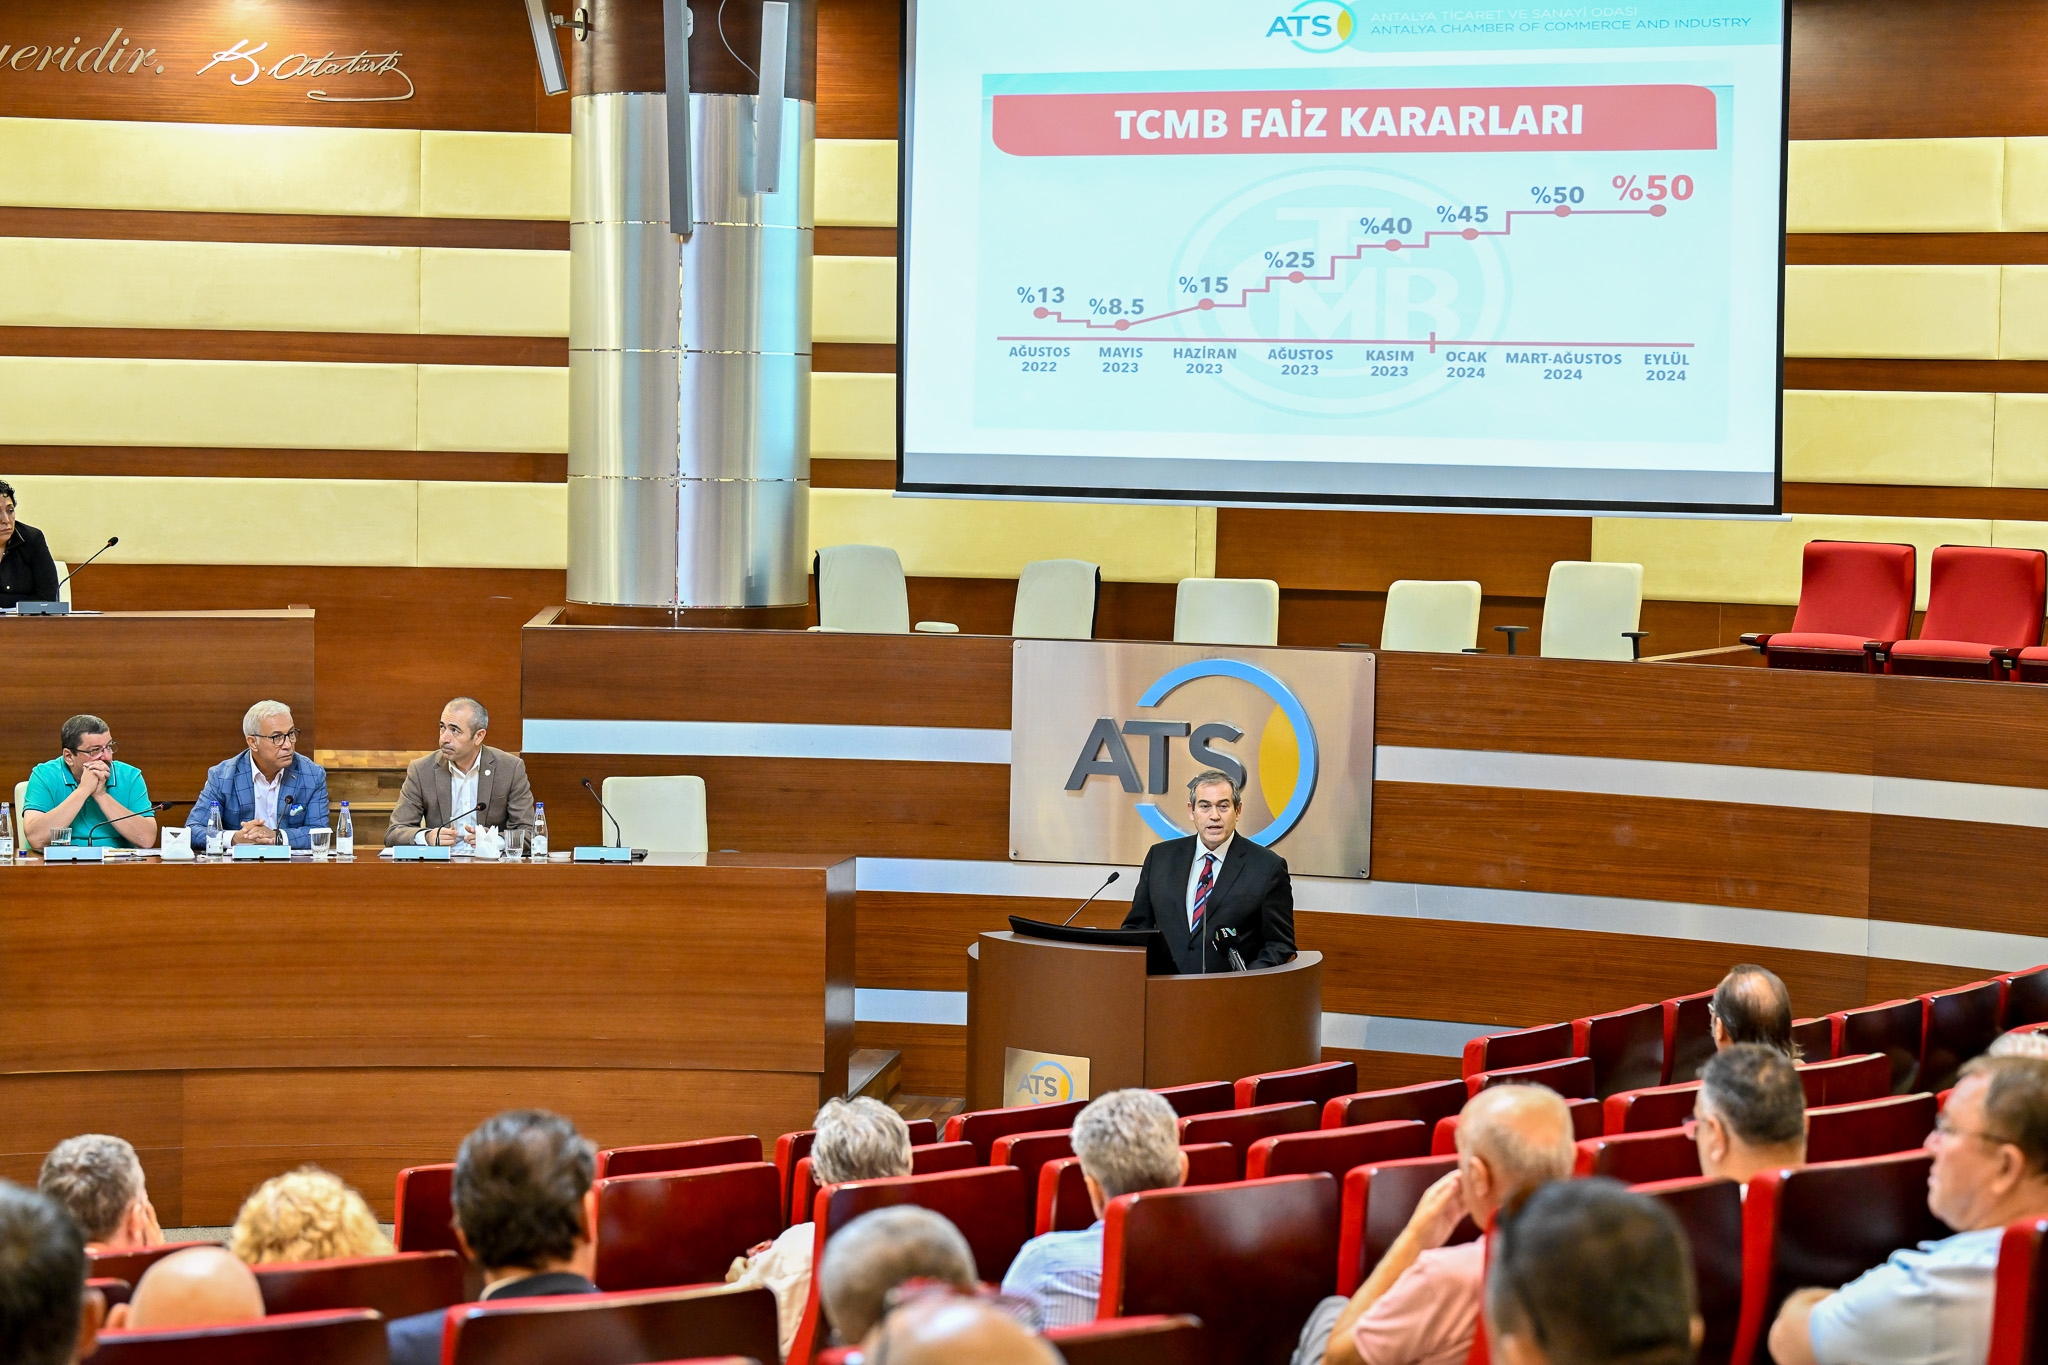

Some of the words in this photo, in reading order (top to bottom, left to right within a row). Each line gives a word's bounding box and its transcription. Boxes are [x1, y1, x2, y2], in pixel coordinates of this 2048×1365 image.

[1370, 11, 1437, 22] ANTALYA
[1440, 9, 1505, 21] TİCARET
[1508, 9, 1528, 19] VE
[1532, 6, 1587, 19] SANAYİ
[1591, 7, 1638, 18] ODASI
[1265, 15, 1332, 38] ATS
[1370, 24, 1437, 35] ANTALYA
[1440, 23, 1515, 34] CHAMBER
[1519, 22, 1540, 32] OF
[1544, 20, 1631, 31] COMMERCE
[1636, 19, 1670, 29] AND
[1674, 17, 1752, 28] INDUSTRY
[1114, 109, 1228, 140] TCMB
[1241, 98, 1327, 139] FAİZ
[1340, 104, 1583, 138] KARARLARI
[1531, 185, 1585, 204] %50
[1612, 174, 1694, 202] %50
[1436, 205, 1489, 224] %45
[1360, 217, 1412, 235] %40
[1264, 251, 1315, 269] %25
[1179, 276, 1229, 294] %15
[1017, 286, 1065, 305] %13
[1089, 298, 1145, 317] %8.5
[1009, 344, 1071, 360] AĞUSTOS
[1099, 346, 1144, 360] MAYIS
[1173, 345, 1237, 360] HAZİRAN
[1268, 346, 1334, 361] AĞUSTOS
[1365, 350, 1415, 363] KASIM
[1446, 351, 1488, 364] OCAK
[1506, 349, 1622, 365] MART-AĞUSTOS
[1644, 350, 1690, 366] EYLÜL
[1021, 360, 1057, 373] 2022
[1102, 361, 1139, 374] 2023
[1186, 362, 1223, 375] 2023
[1281, 364, 1319, 376] 2023
[1370, 365, 1409, 378] 2023
[1446, 366, 1486, 379] 2024
[1543, 367, 1583, 381] 2024
[1646, 368, 1687, 382] 2024
[1064, 717, 1248, 795] ATS
[1016, 1073, 1058, 1097] ATS
